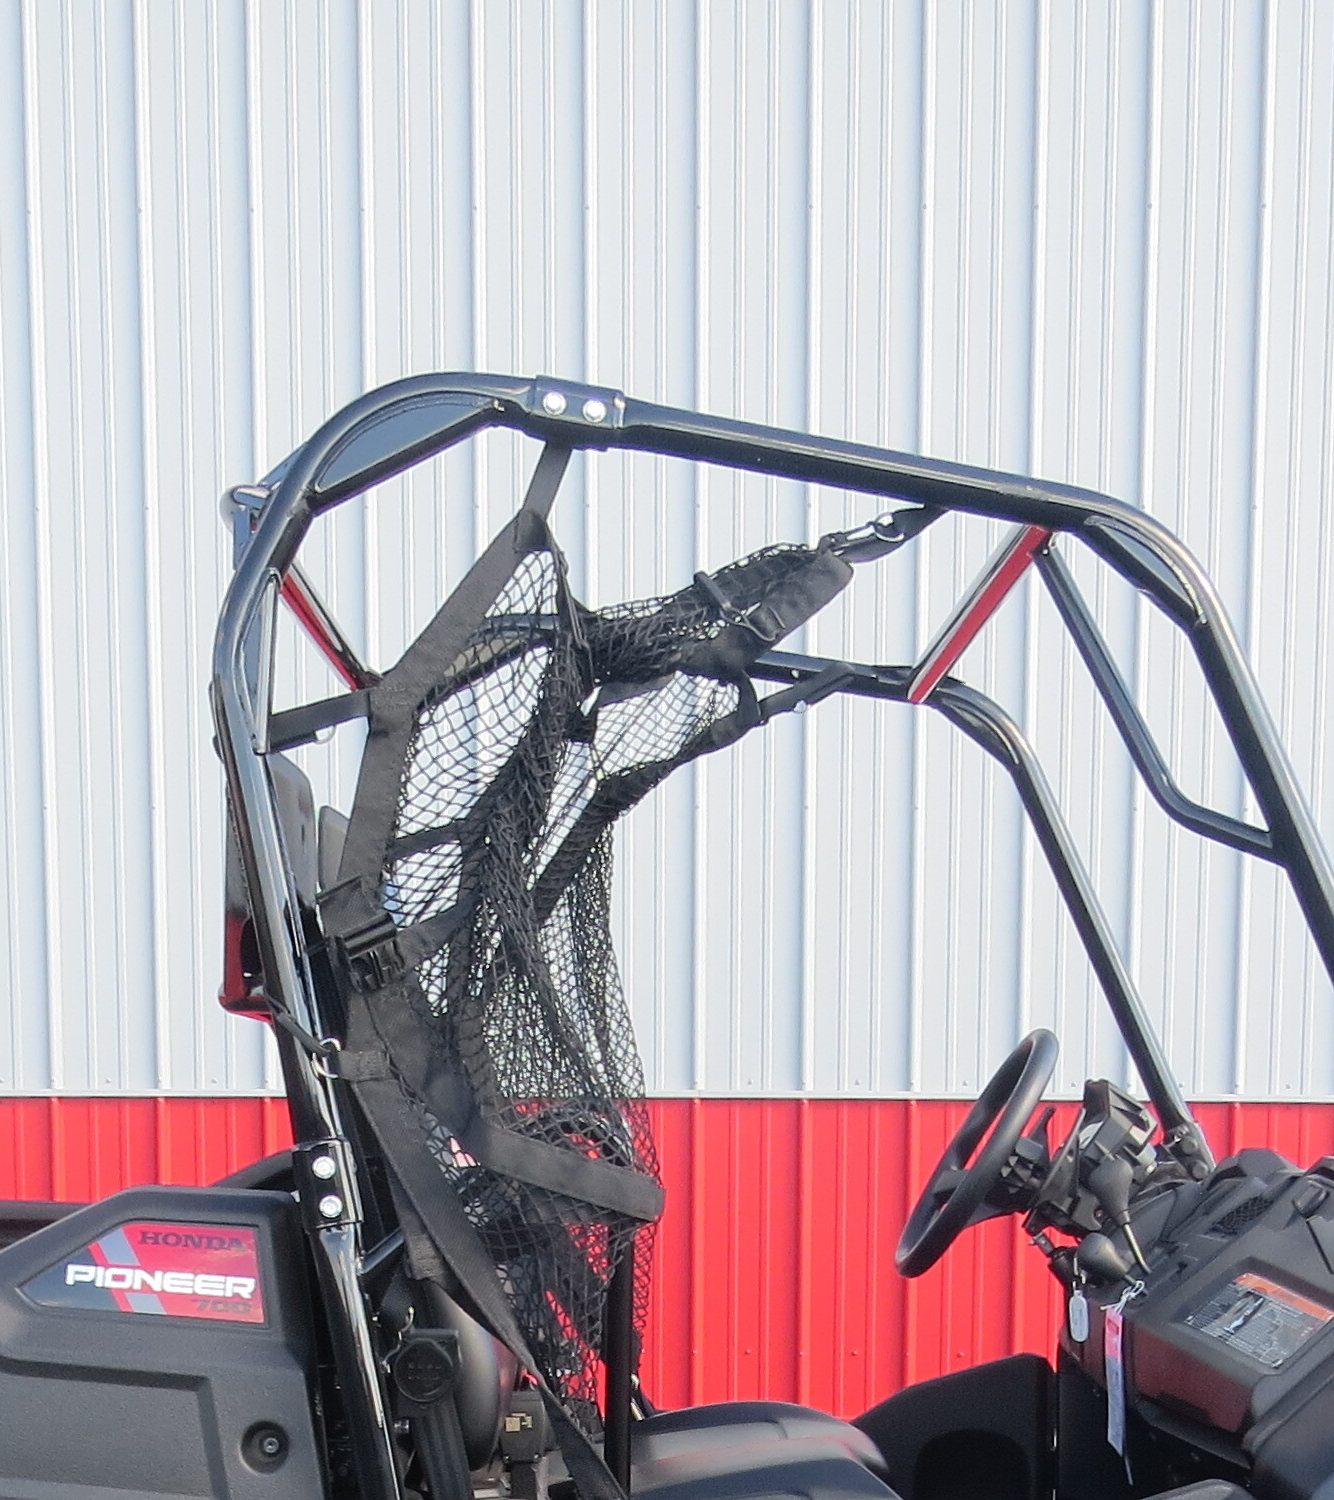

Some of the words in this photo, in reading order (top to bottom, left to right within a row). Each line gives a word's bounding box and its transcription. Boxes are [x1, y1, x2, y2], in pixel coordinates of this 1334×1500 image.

[138, 1230, 245, 1251] HONDA
[65, 1263, 256, 1299] PIONEER
[192, 1298, 253, 1315] 700
